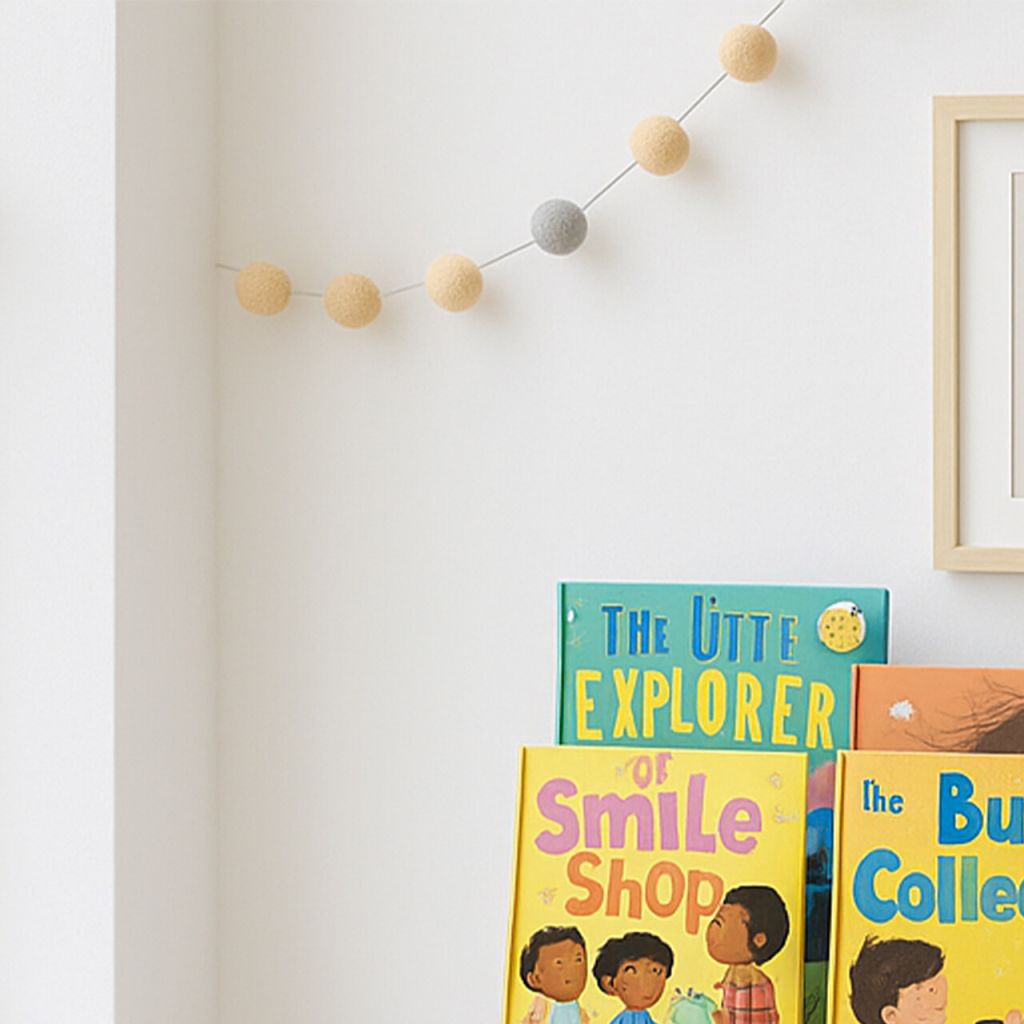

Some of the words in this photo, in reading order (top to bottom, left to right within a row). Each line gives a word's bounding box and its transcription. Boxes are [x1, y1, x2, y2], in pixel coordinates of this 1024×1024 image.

[602, 606, 670, 656] THE
[575, 667, 836, 749] EXPLORER
[564, 851, 724, 935] Shop
